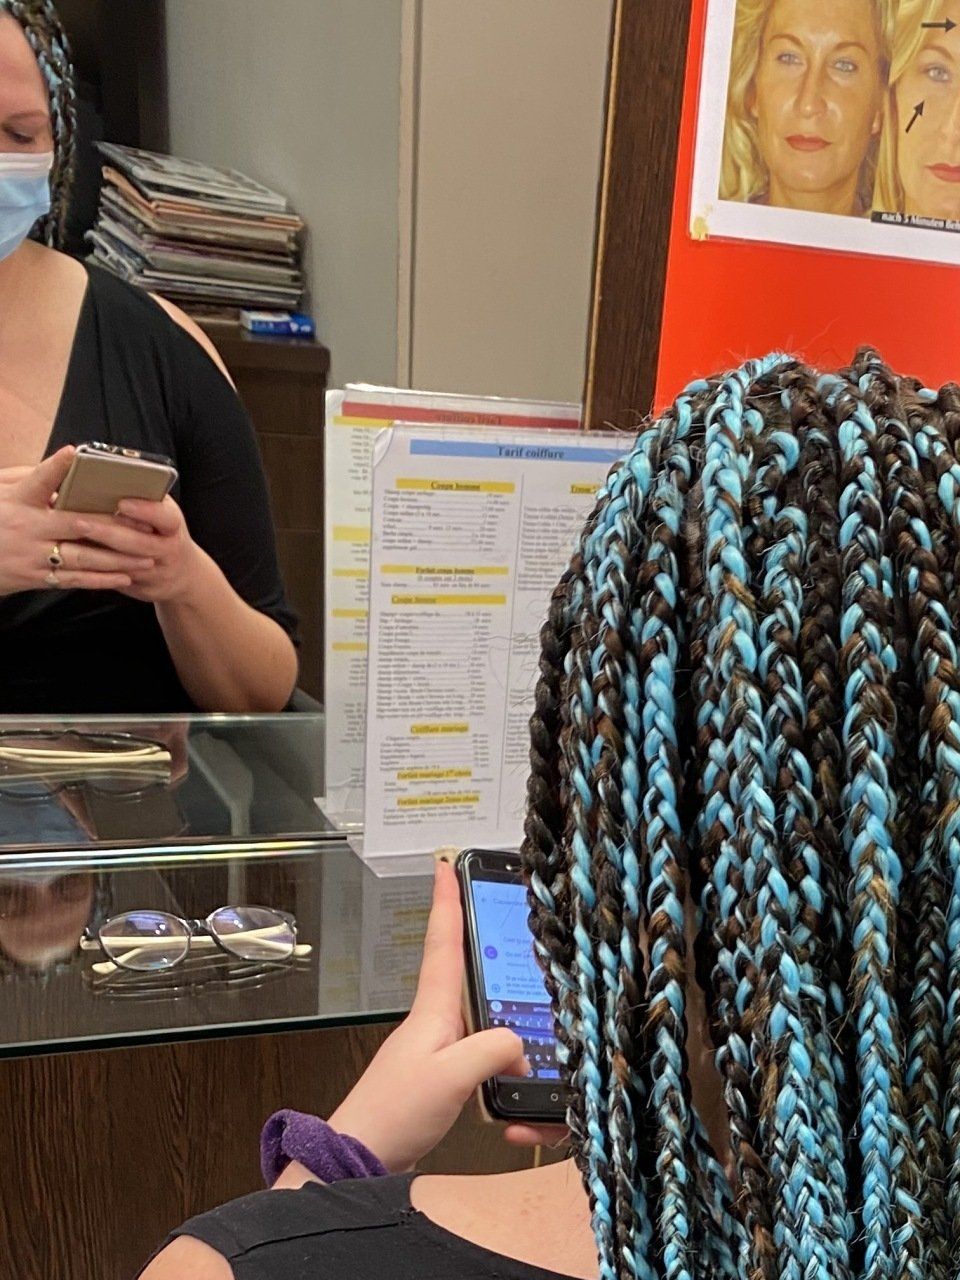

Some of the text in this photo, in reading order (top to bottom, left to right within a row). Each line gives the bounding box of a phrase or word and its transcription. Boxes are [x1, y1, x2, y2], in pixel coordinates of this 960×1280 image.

[882, 212, 902, 222] nach
[910, 214, 944, 229] Minuten
[498, 446, 564, 459] Tarif coiffure
